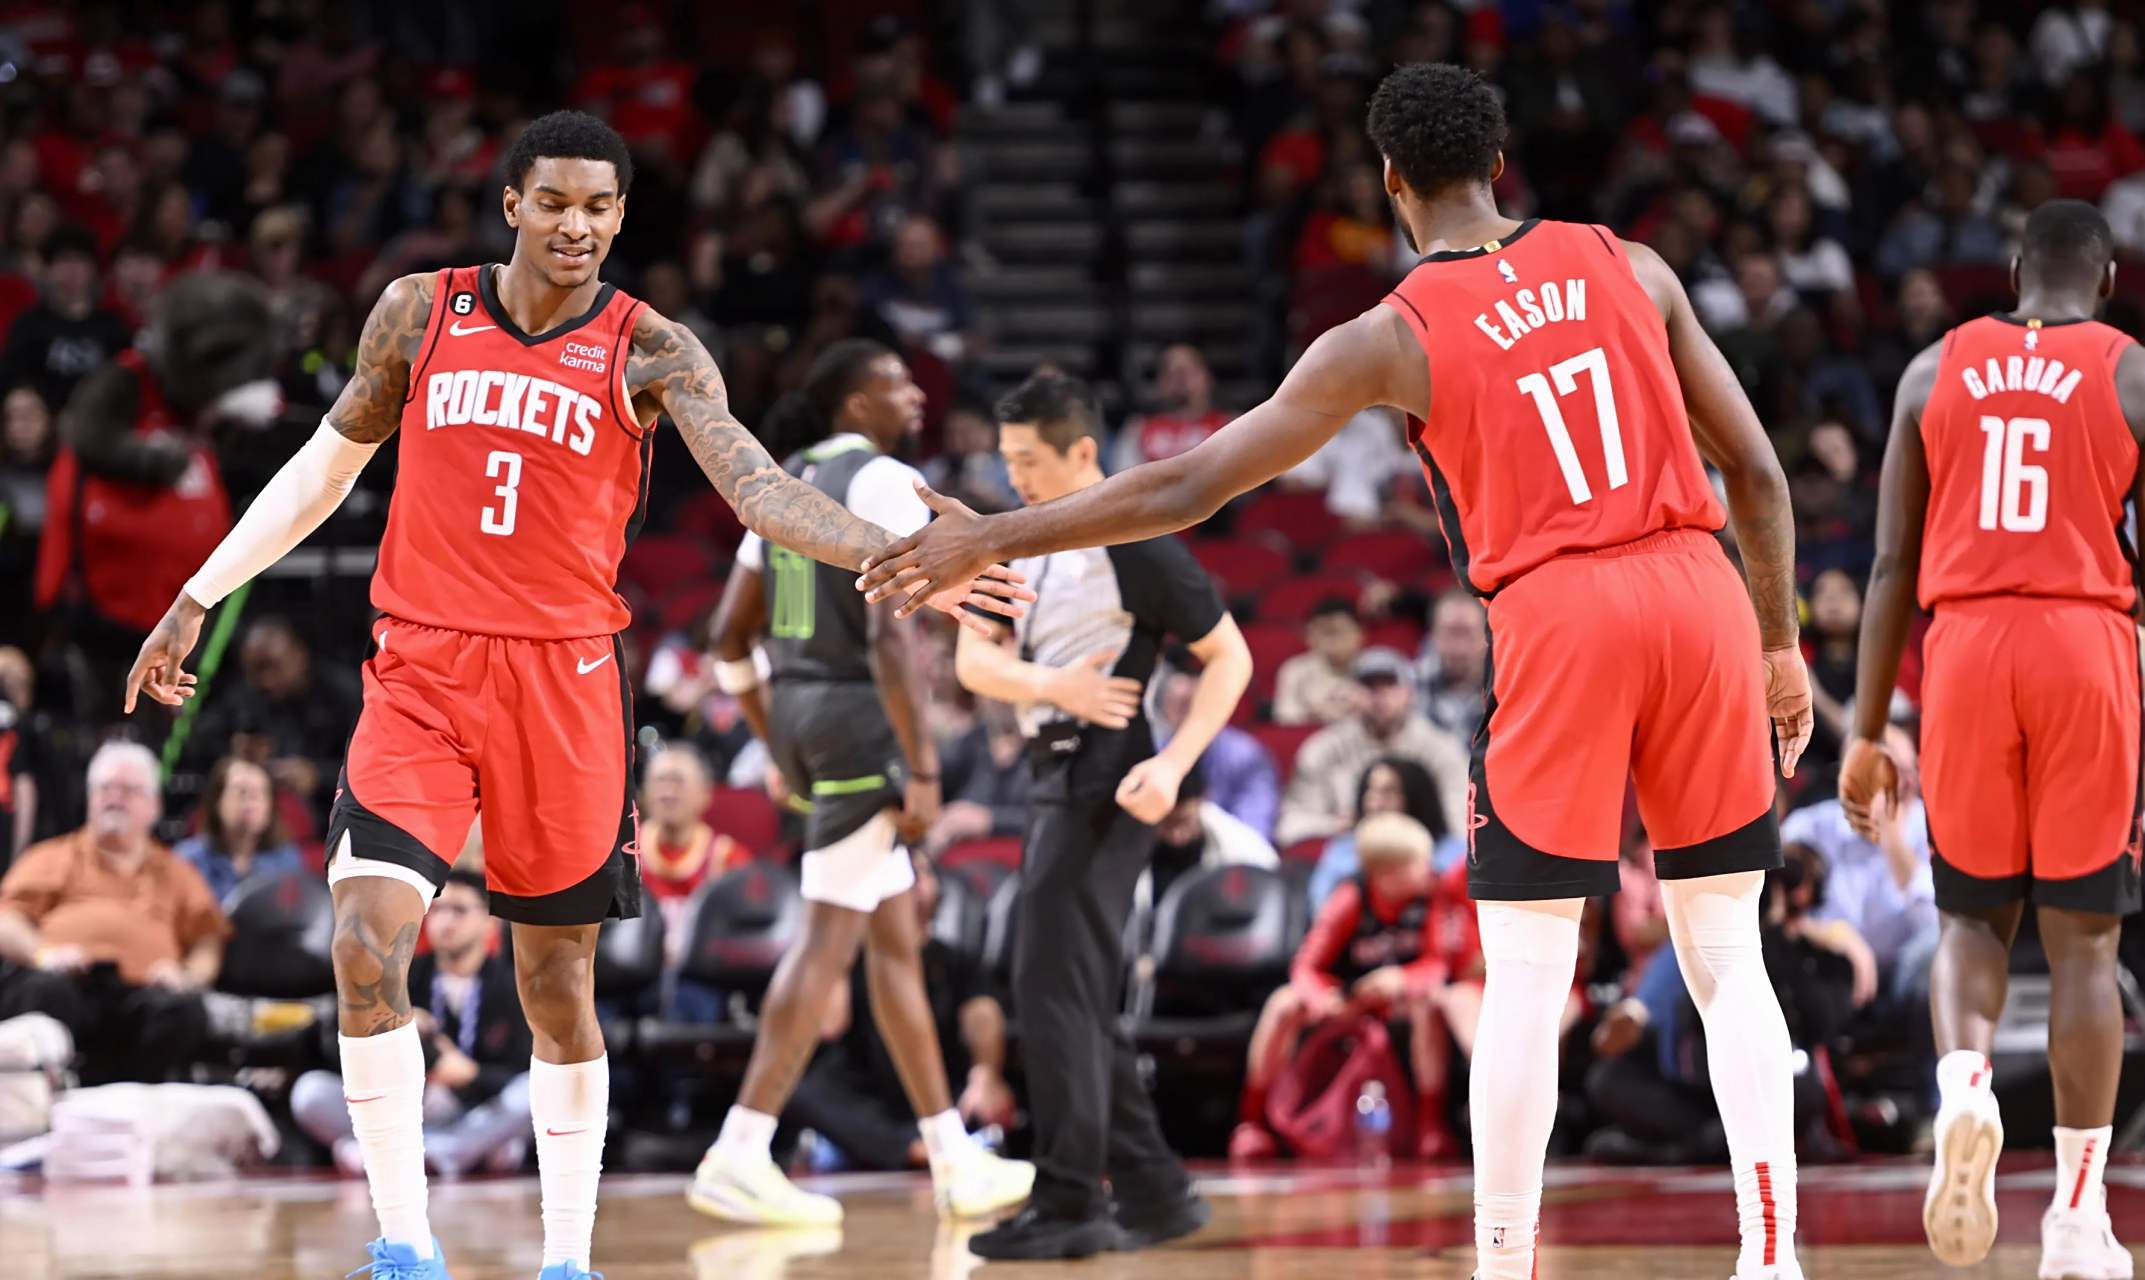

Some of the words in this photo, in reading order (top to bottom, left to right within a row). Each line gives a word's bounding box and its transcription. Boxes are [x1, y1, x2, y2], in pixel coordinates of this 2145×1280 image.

[454, 294, 472, 314] 6
[1473, 279, 1586, 350] EASON
[560, 351, 605, 373] karma
[566, 342, 606, 361] credit
[1962, 355, 2083, 404] GARUBA
[427, 370, 601, 456] ROCKETS
[1516, 347, 1628, 505] 17
[480, 451, 522, 536] 3
[1979, 415, 2051, 532] 16
